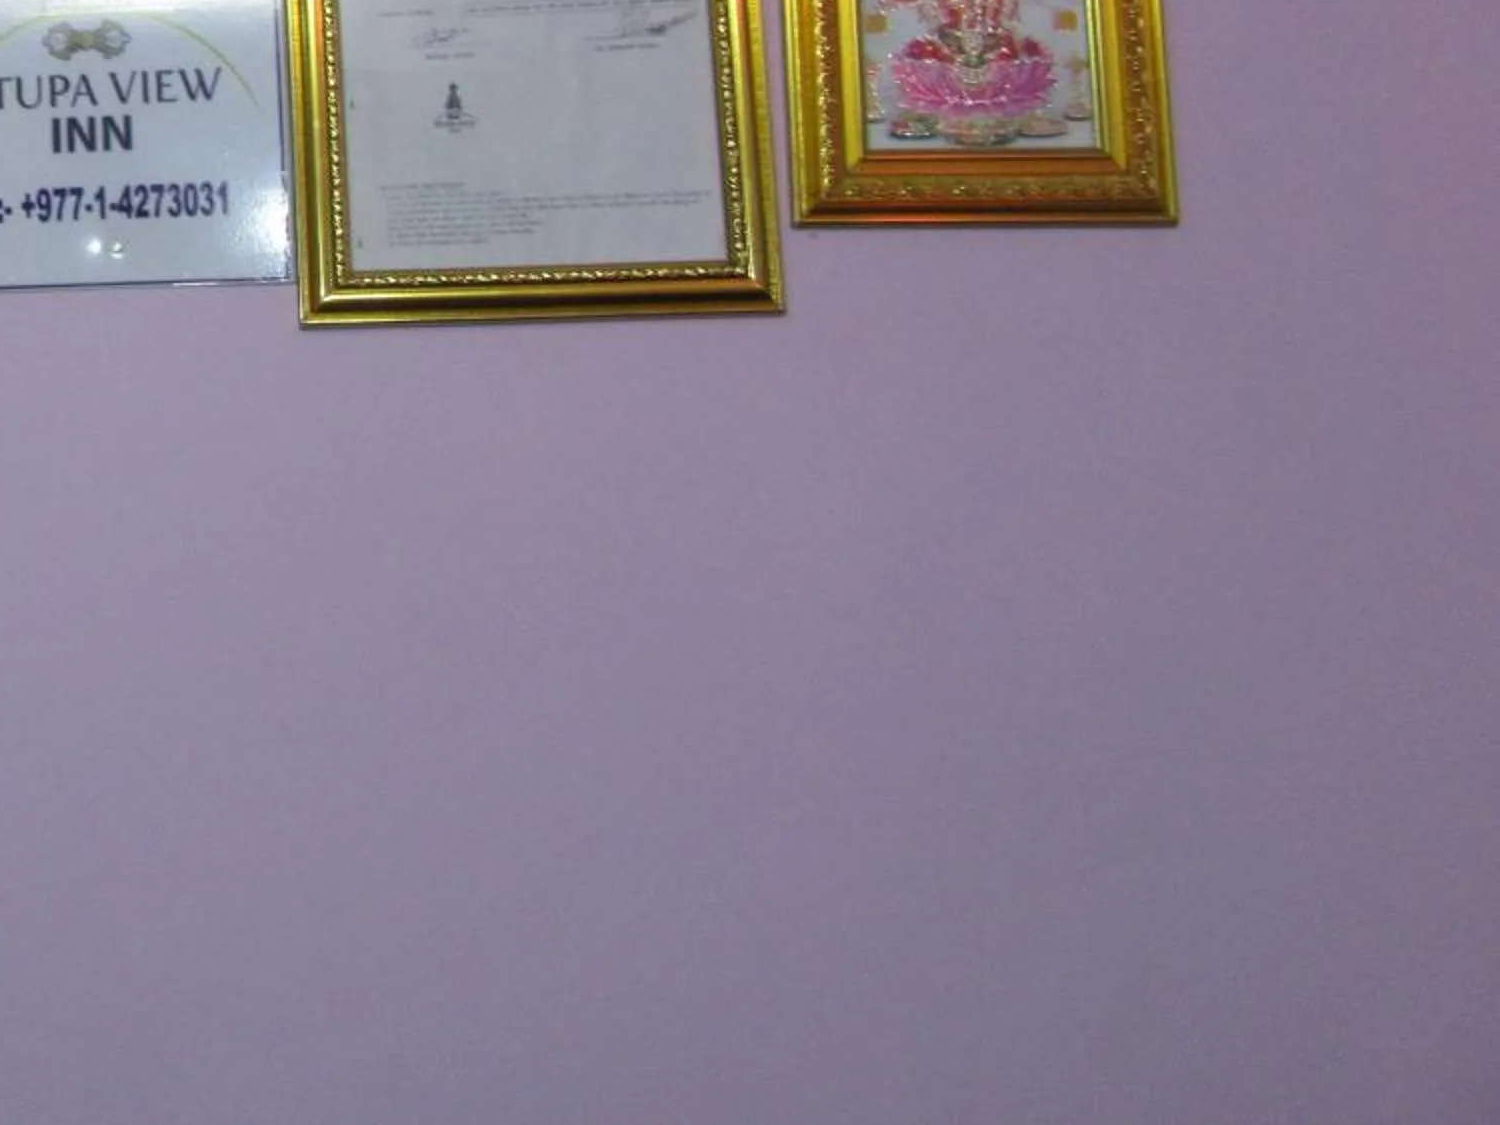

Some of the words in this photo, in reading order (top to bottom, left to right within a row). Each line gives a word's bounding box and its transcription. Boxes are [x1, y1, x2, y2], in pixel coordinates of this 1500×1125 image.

[108, 67, 222, 105] VIEW
[51, 115, 134, 154] INN
[21, 181, 229, 223] +977-1-4273031
